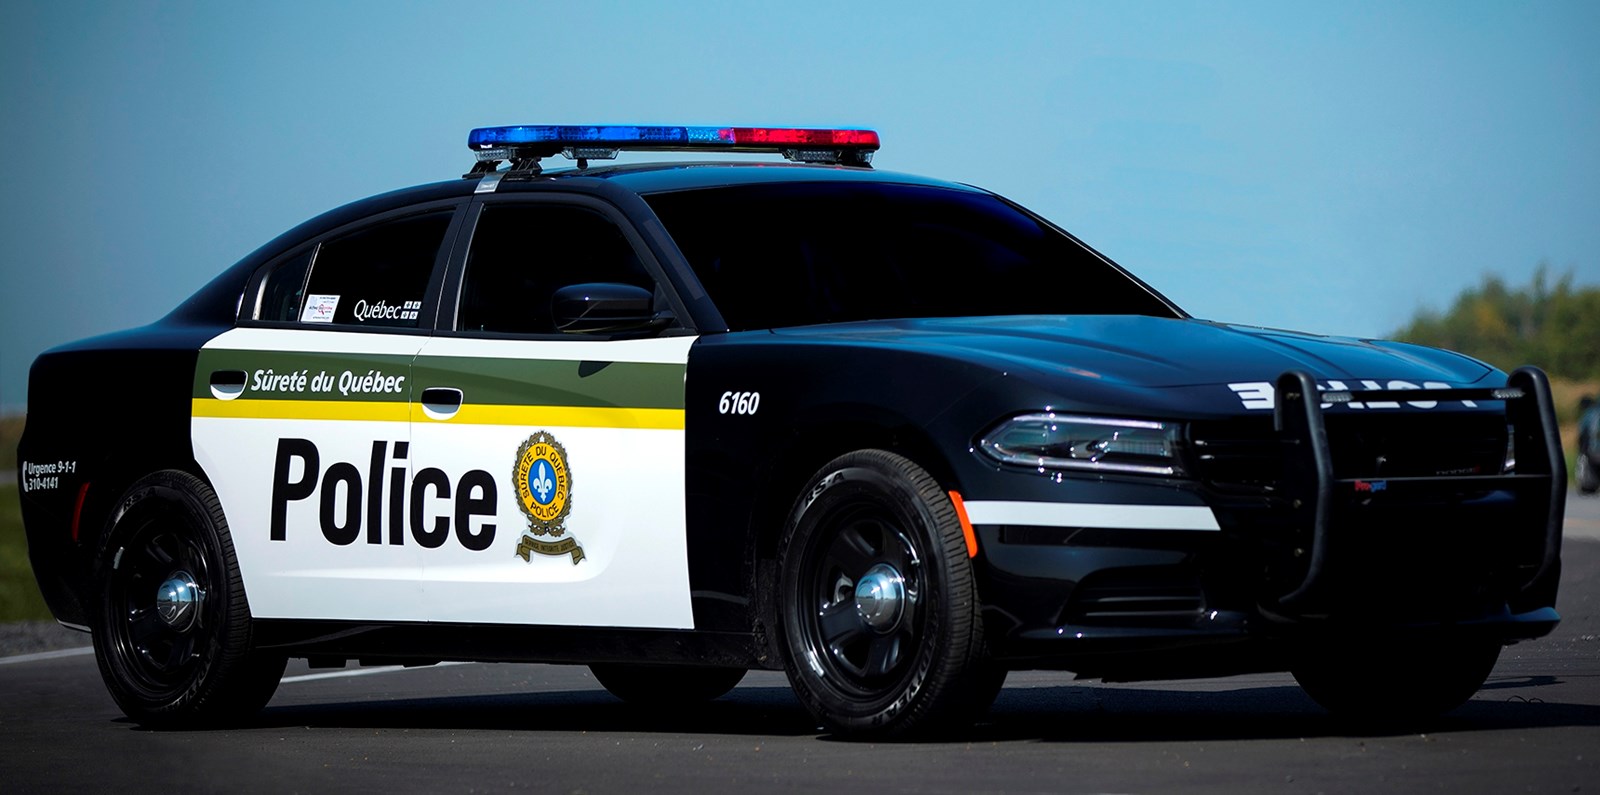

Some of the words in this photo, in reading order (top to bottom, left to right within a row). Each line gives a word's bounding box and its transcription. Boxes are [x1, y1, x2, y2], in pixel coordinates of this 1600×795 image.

[353, 299, 402, 321] Québec
[250, 369, 308, 392] Sûreté
[311, 371, 335, 392] du
[338, 370, 405, 396] Québec
[719, 391, 760, 415] 6160
[535, 446, 547, 456] DU
[28, 462, 56, 477] Urgence
[57, 460, 77, 474] 9-1-1
[29, 476, 59, 491] 310-4141
[270, 437, 498, 551] Police
[530, 501, 560, 518] POLICE
